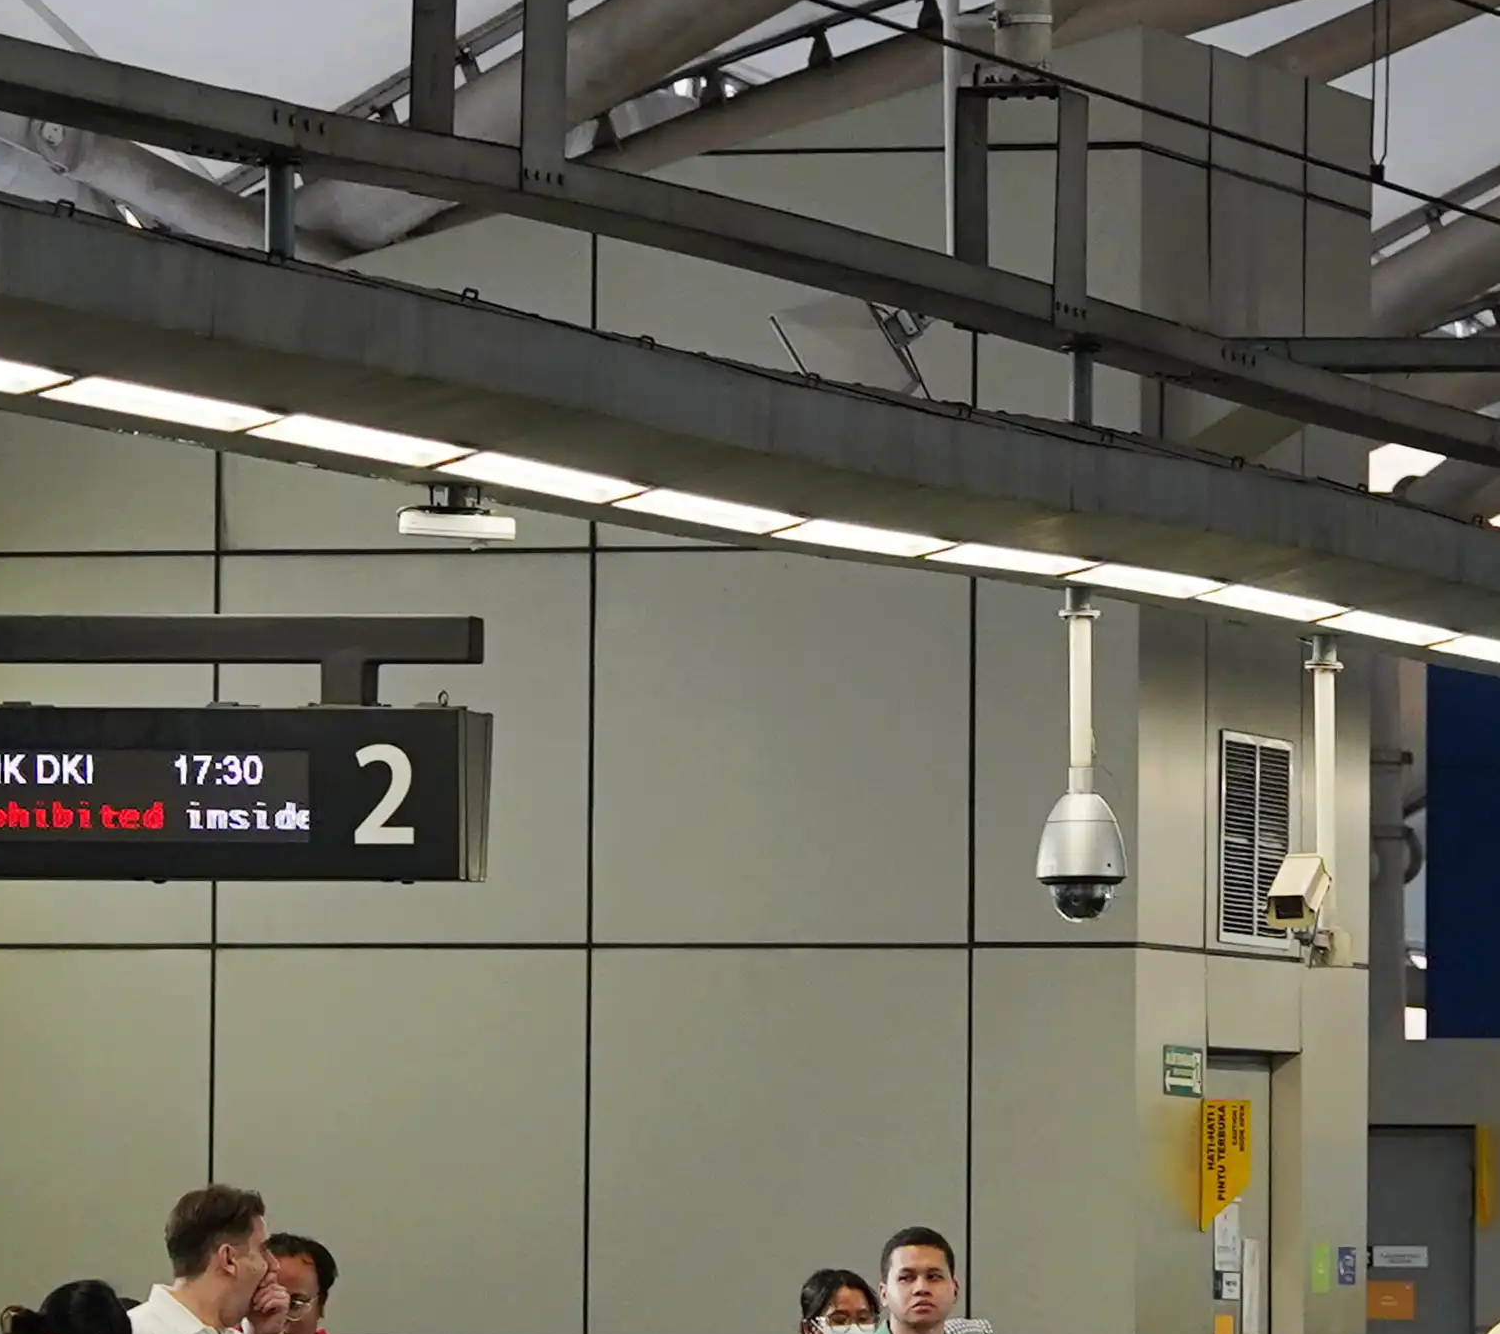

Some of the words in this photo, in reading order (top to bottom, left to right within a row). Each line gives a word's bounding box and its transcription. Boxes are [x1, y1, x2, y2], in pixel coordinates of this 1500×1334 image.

[36, 755, 94, 785] DKI
[174, 754, 264, 786] 17:30
[354, 743, 415, 845] 2
[1217, 1105, 1226, 1161] TERBUKA
[1217, 1165, 1226, 1201] PINTU
